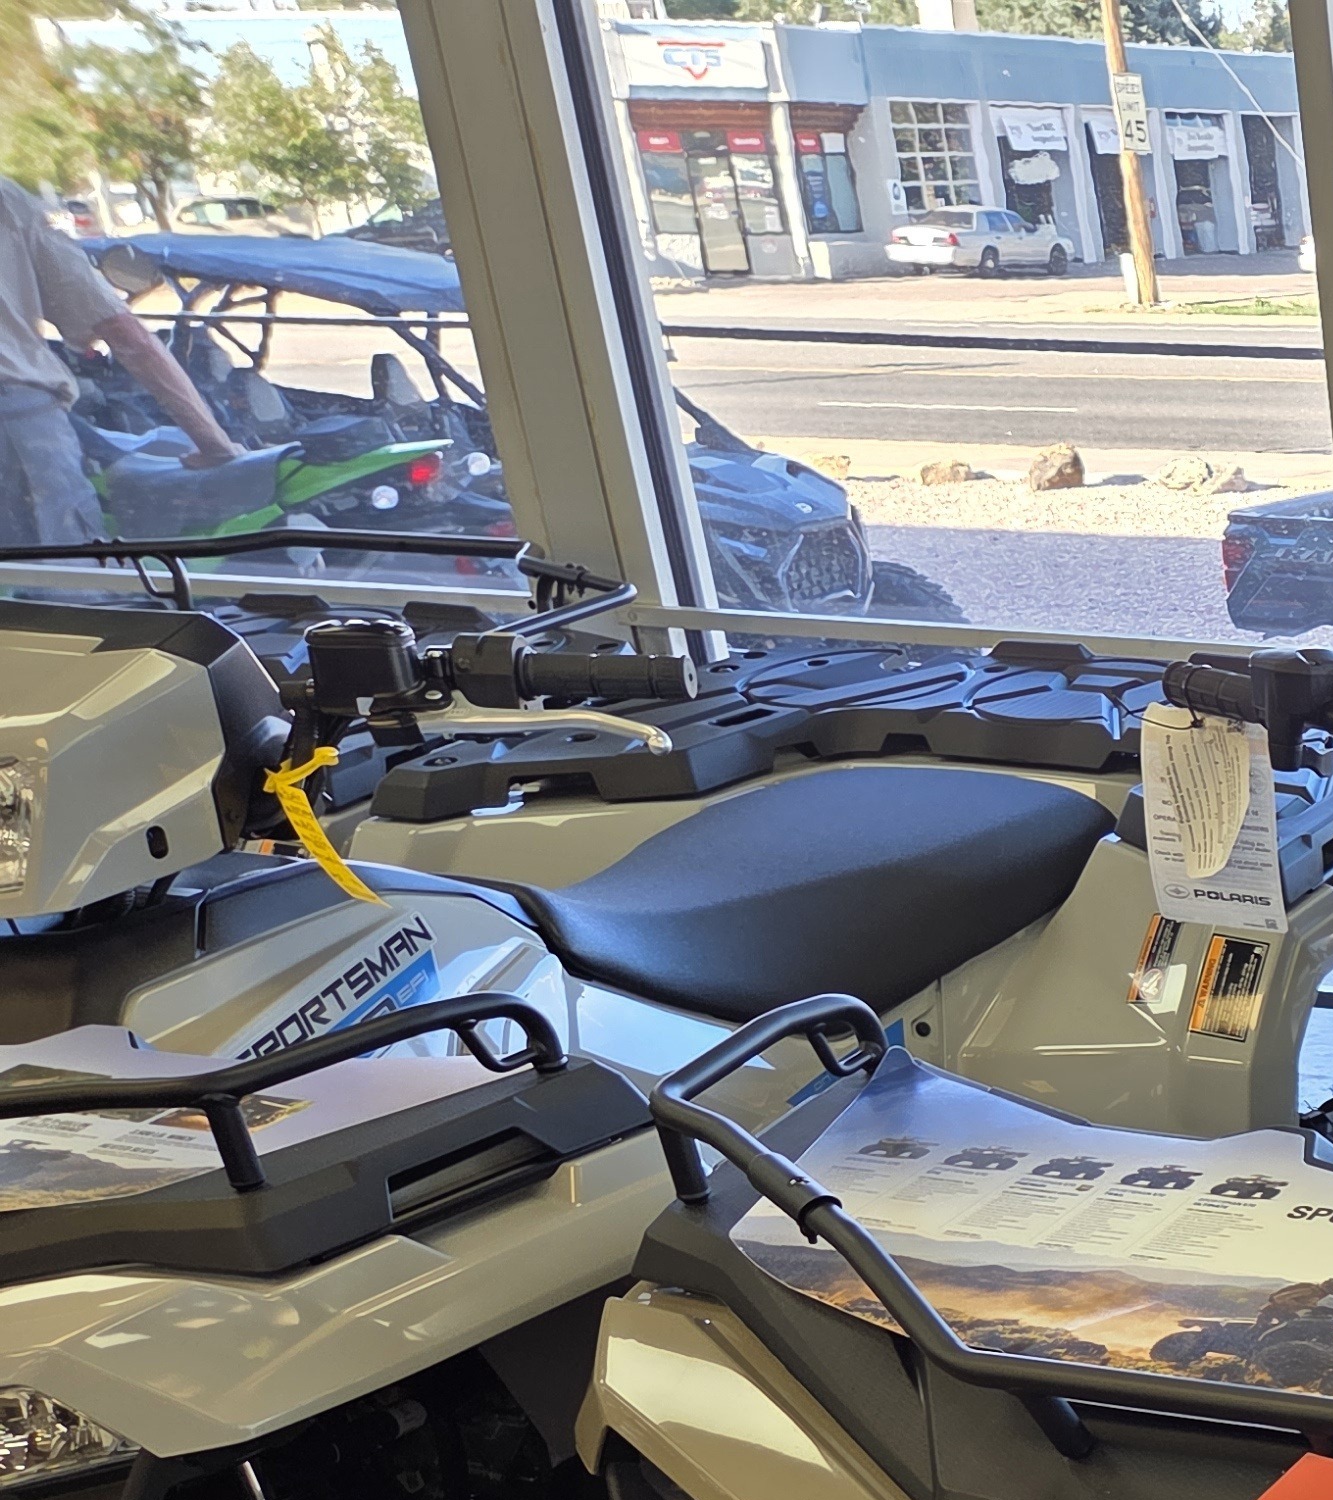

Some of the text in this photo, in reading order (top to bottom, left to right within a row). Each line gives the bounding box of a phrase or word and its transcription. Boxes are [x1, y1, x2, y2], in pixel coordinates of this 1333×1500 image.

[1115, 81, 1141, 94] SPEED
[1121, 101, 1141, 113] LIMIT
[1124, 118, 1148, 144] 45
[1193, 888, 1272, 907] POLARIS
